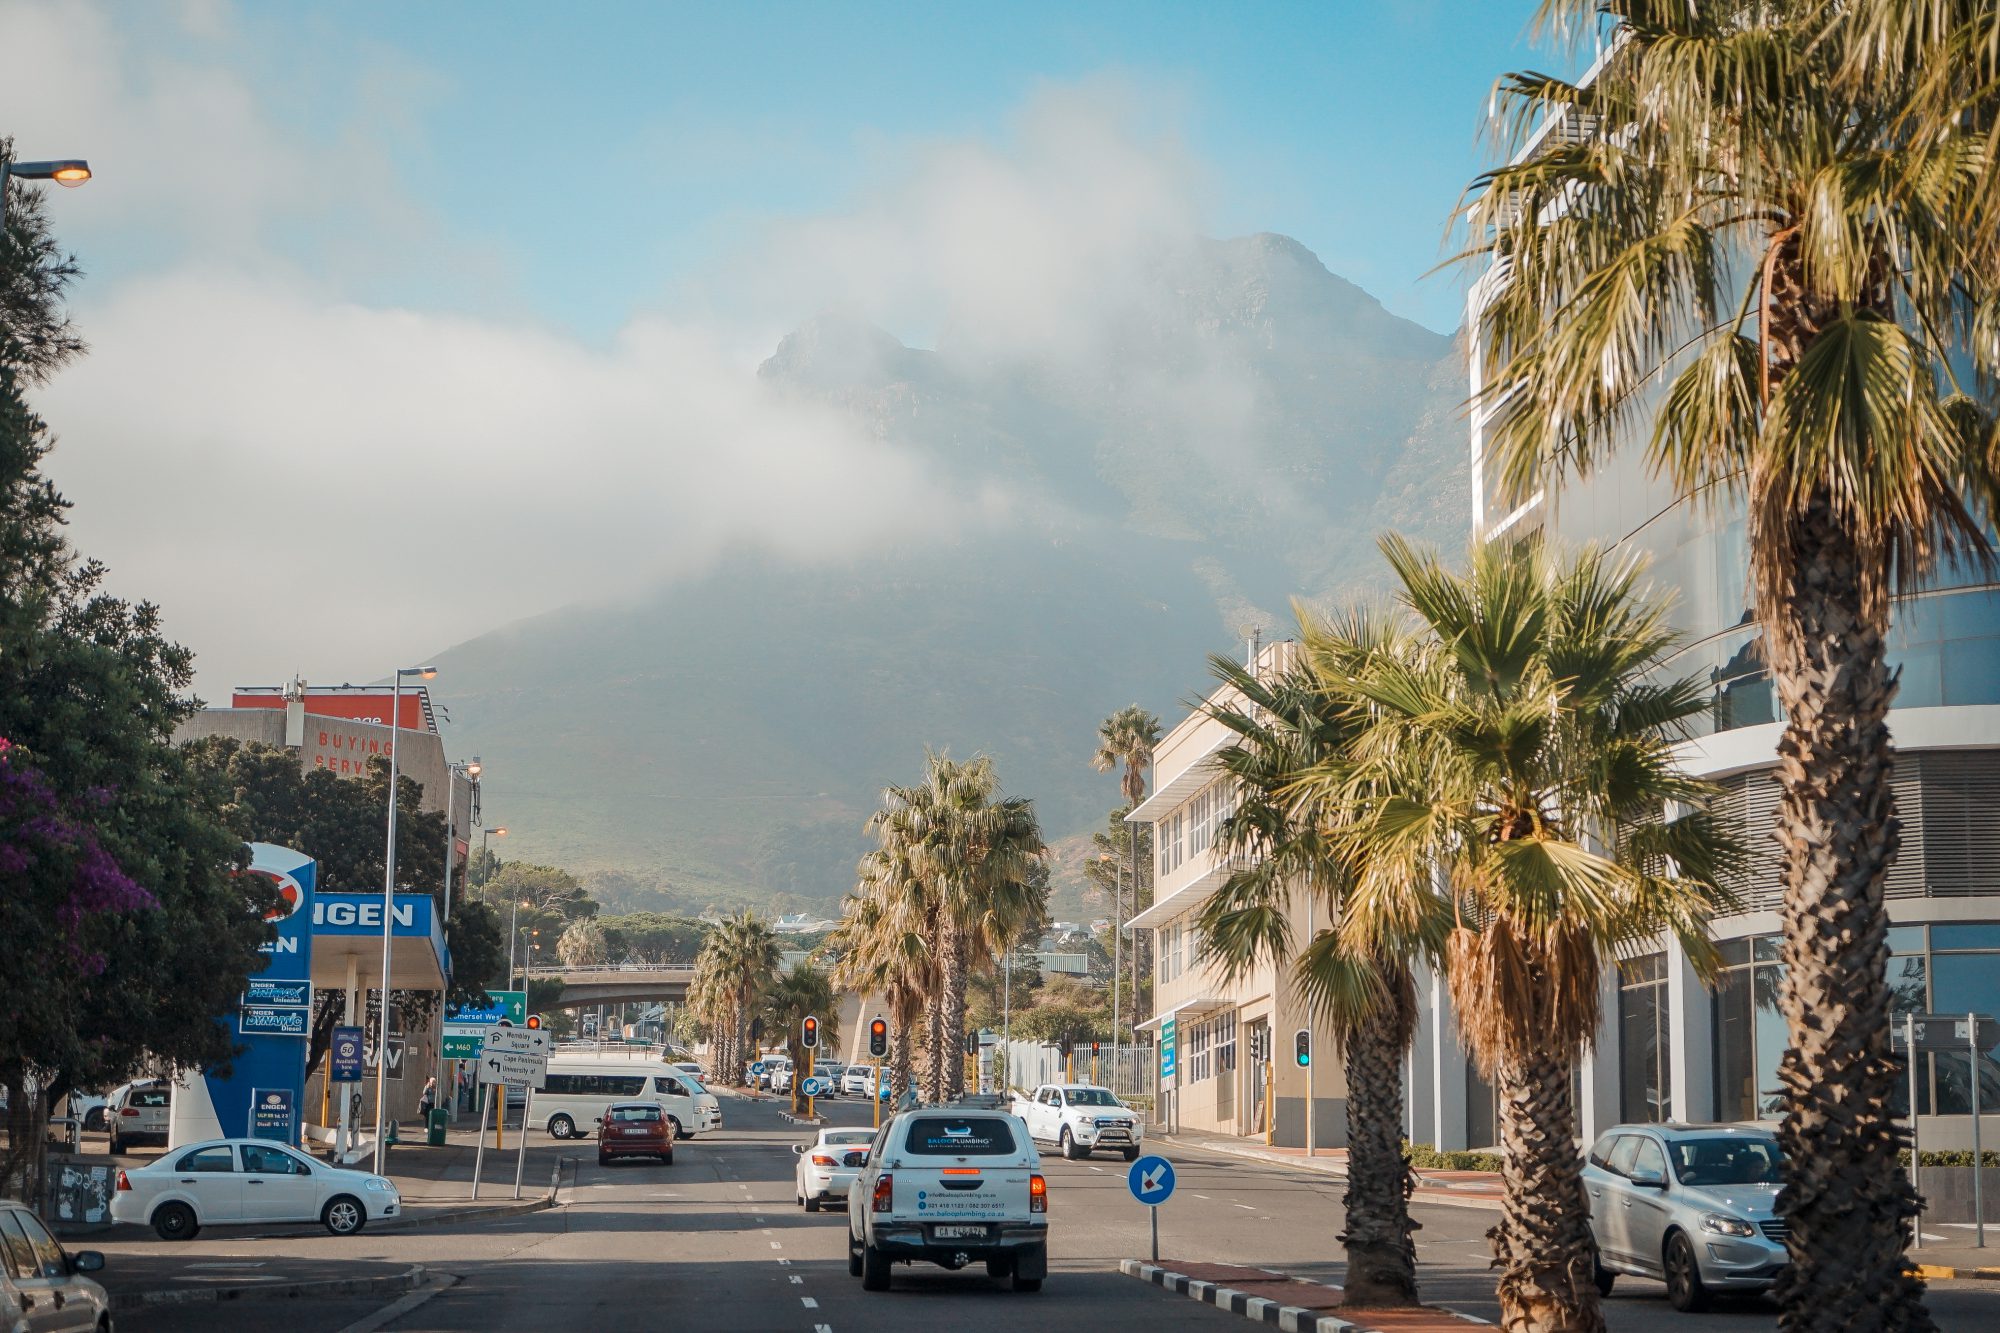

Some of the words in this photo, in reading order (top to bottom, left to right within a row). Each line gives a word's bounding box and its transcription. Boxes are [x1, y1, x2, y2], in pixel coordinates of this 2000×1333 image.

[319, 731, 393, 756] BUYING
[506, 1031, 531, 1041] Wembley
[341, 1046, 354, 1054] 50
[511, 1041, 530, 1050] Square
[503, 1055, 517, 1063] Cape
[518, 1056, 543, 1065] Peninsula
[502, 1065, 529, 1076] University
[502, 1076, 532, 1087] Technology
[918, 1210, 1005, 1218] www.balooplumbing.co.za
[940, 1227, 949, 1237] CA
